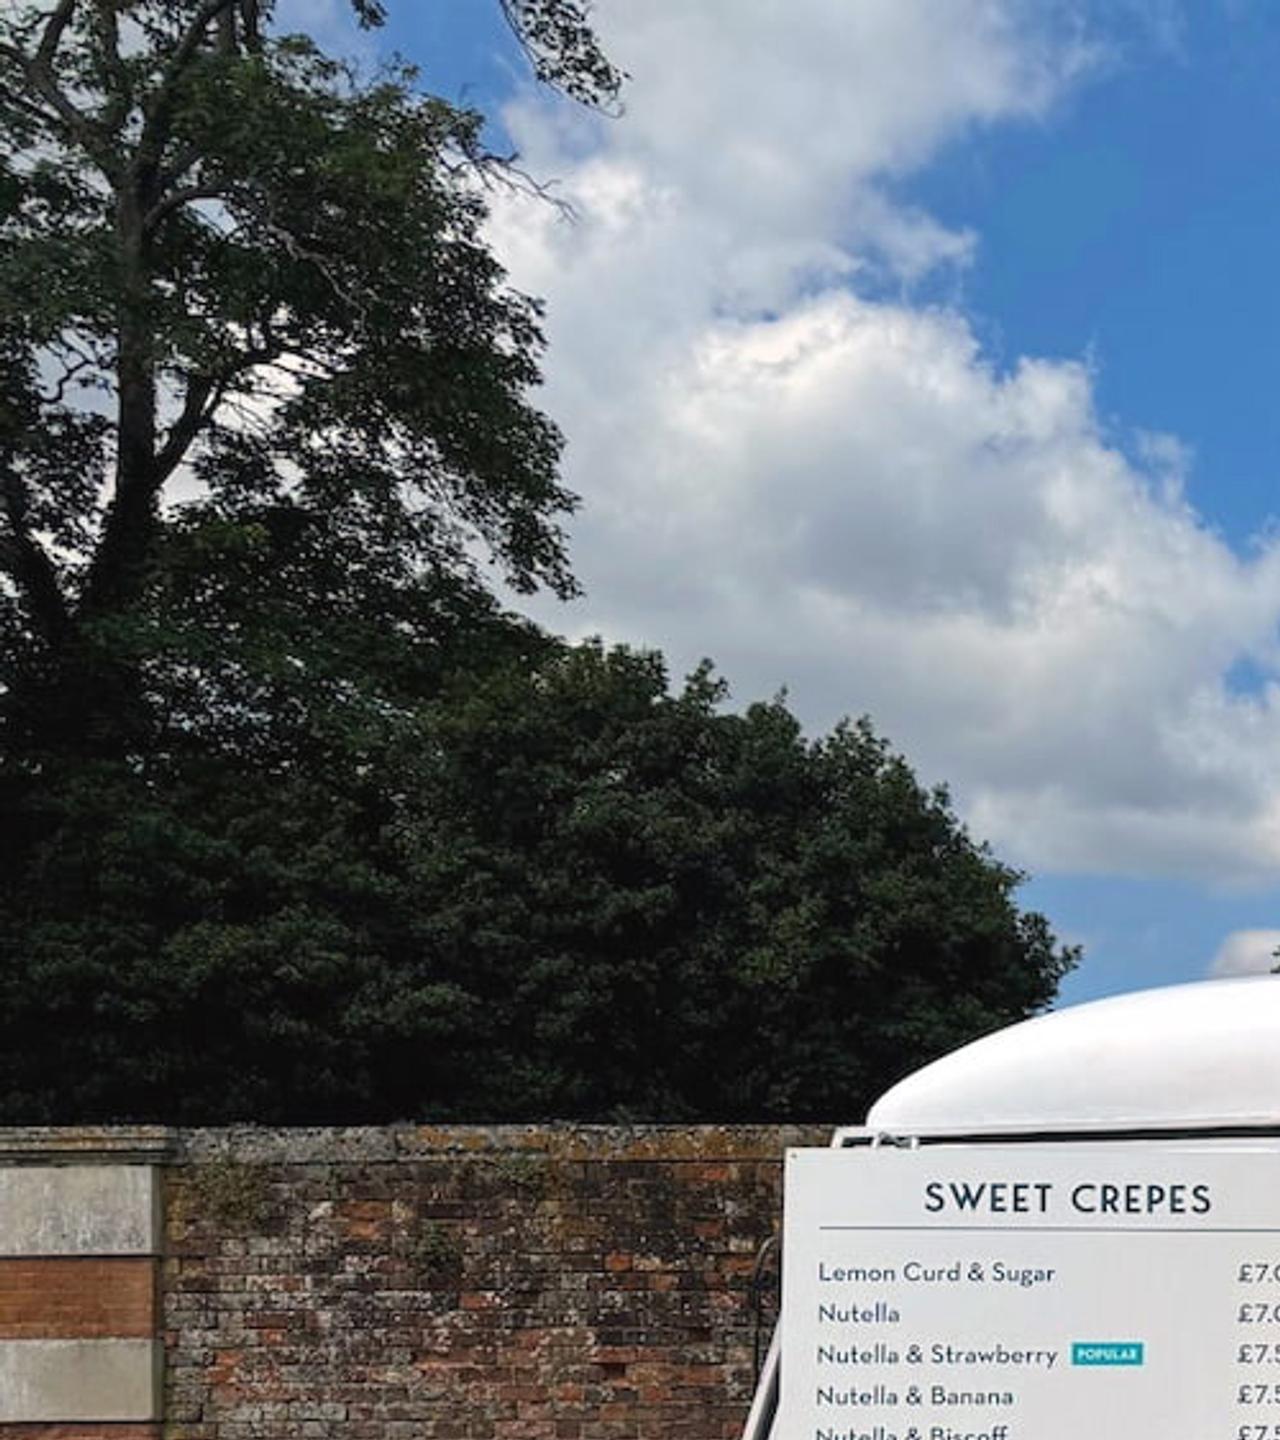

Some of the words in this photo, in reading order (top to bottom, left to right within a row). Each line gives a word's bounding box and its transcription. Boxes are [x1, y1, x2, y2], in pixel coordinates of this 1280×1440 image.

[925, 1182, 1053, 1213] SWEET
[1071, 1183, 1211, 1215] CREPES
[818, 1261, 896, 1282] Lemon
[903, 1261, 962, 1283] Curd
[967, 1261, 985, 1282] &
[992, 1261, 1056, 1288] Sugar
[818, 1301, 900, 1324] Nutella
[816, 1343, 900, 1365] Nutella
[905, 1343, 923, 1365] &
[931, 1343, 1059, 1370] Strawberry
[1077, 1348, 1137, 1361] POPULAR
[816, 1384, 899, 1406] Nutella
[905, 1385, 922, 1406] &
[931, 1385, 1014, 1406] Banana
